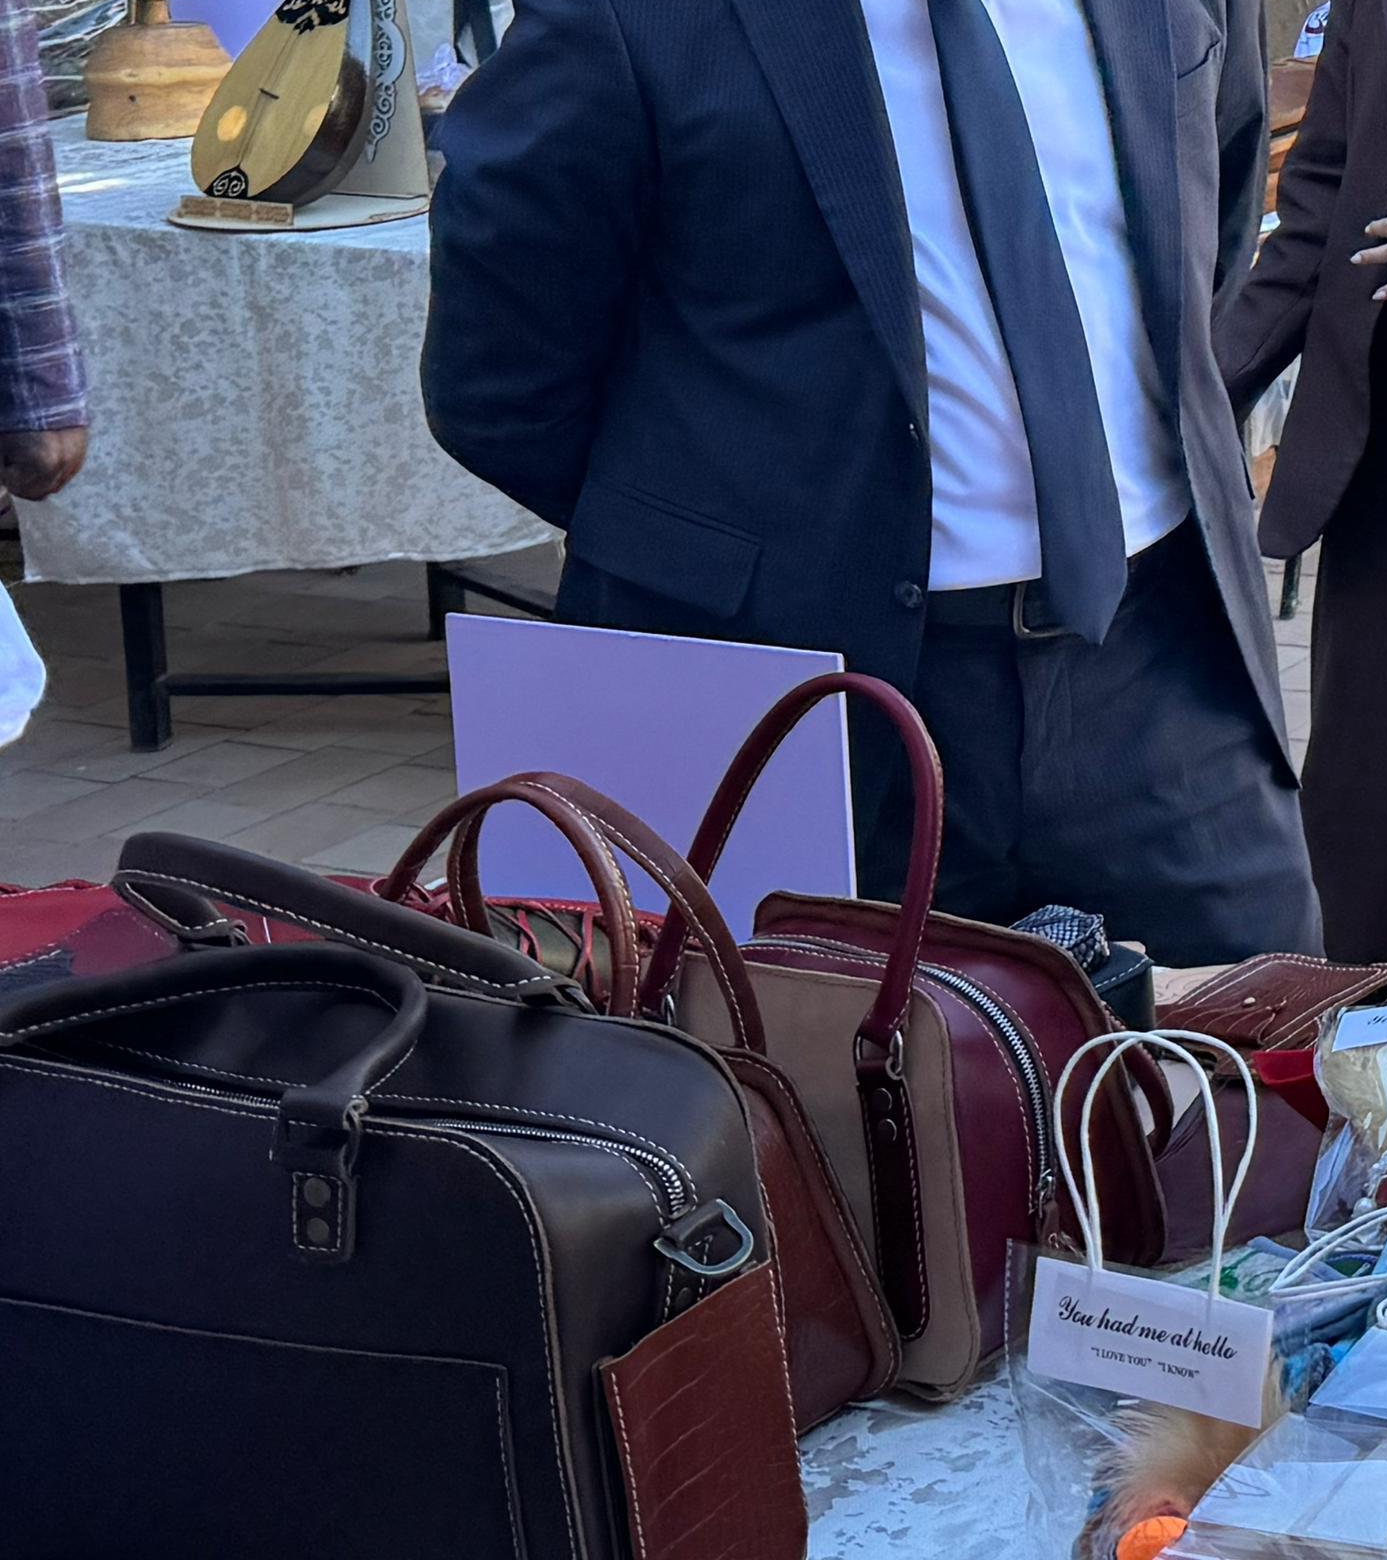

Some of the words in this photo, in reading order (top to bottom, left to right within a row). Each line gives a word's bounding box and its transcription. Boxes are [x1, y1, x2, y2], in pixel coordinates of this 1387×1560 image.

[1058, 1295, 1097, 1327] You
[1097, 1307, 1140, 1336] had
[1138, 1326, 1170, 1343] me
[1170, 1327, 1195, 1348] at
[1192, 1330, 1239, 1360] hello
[1101, 1348, 1126, 1362] LOVE
